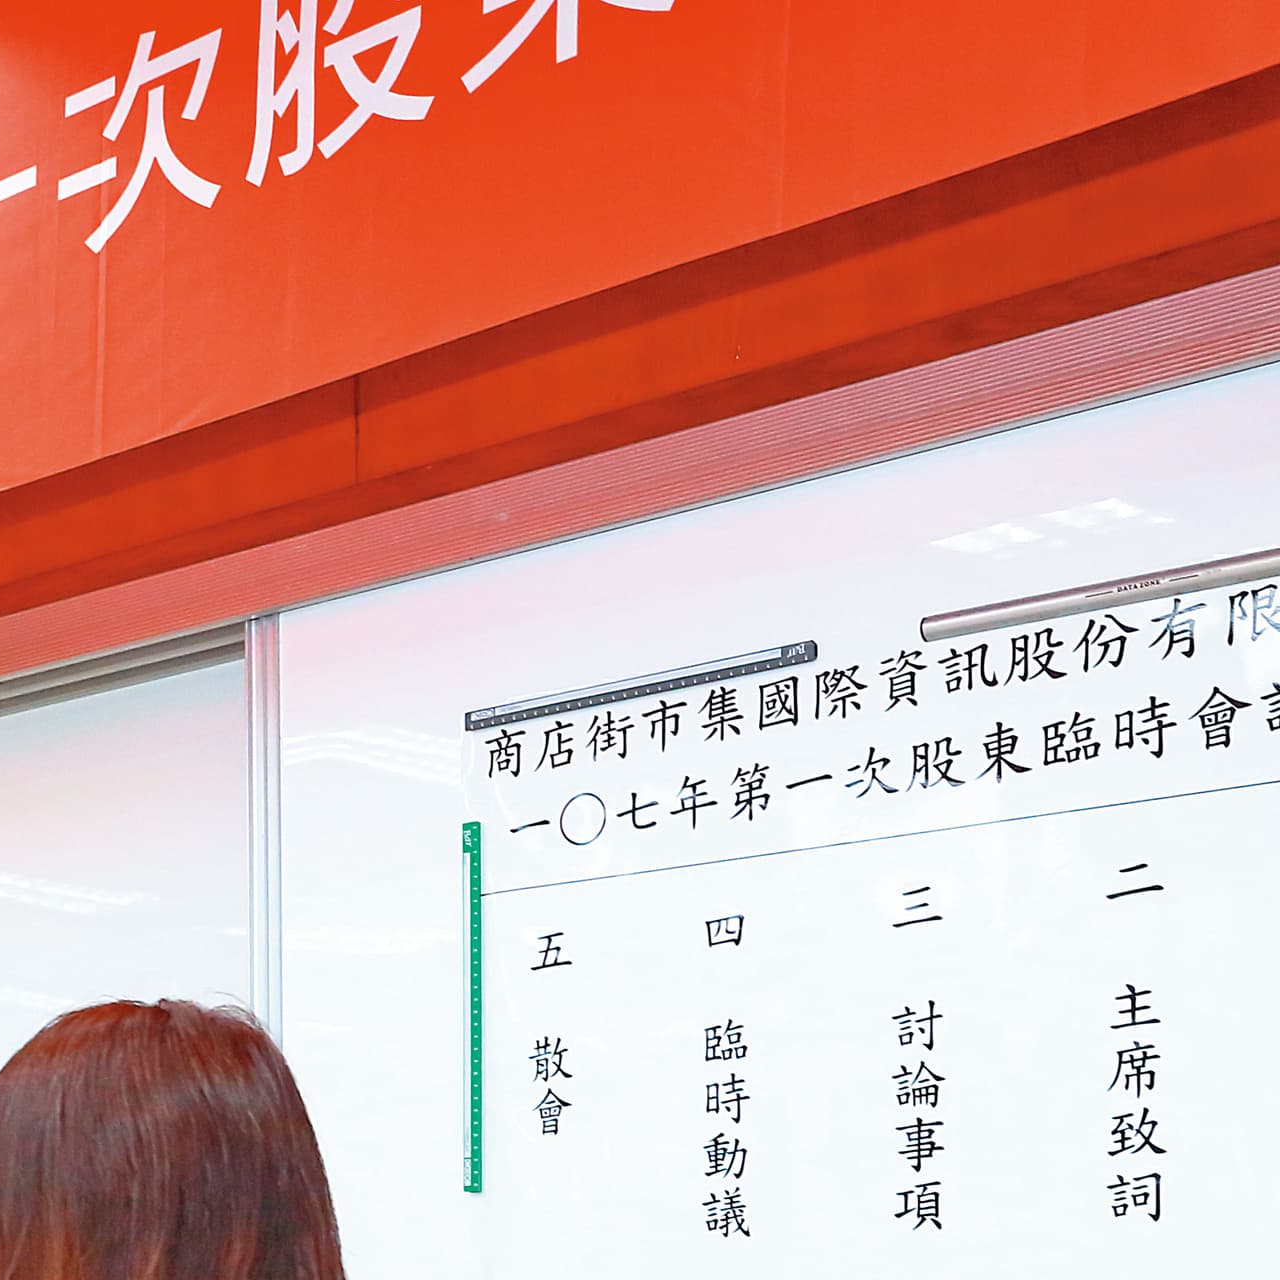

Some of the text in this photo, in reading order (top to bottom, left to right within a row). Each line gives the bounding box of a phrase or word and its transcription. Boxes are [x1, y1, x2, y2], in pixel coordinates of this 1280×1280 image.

[527, 932, 573, 1136] 五 散會
[701, 914, 752, 1238] 四 臨時動議
[890, 886, 946, 1232] 三 討論事項
[1104, 863, 1168, 1223] 二 主席致詞
